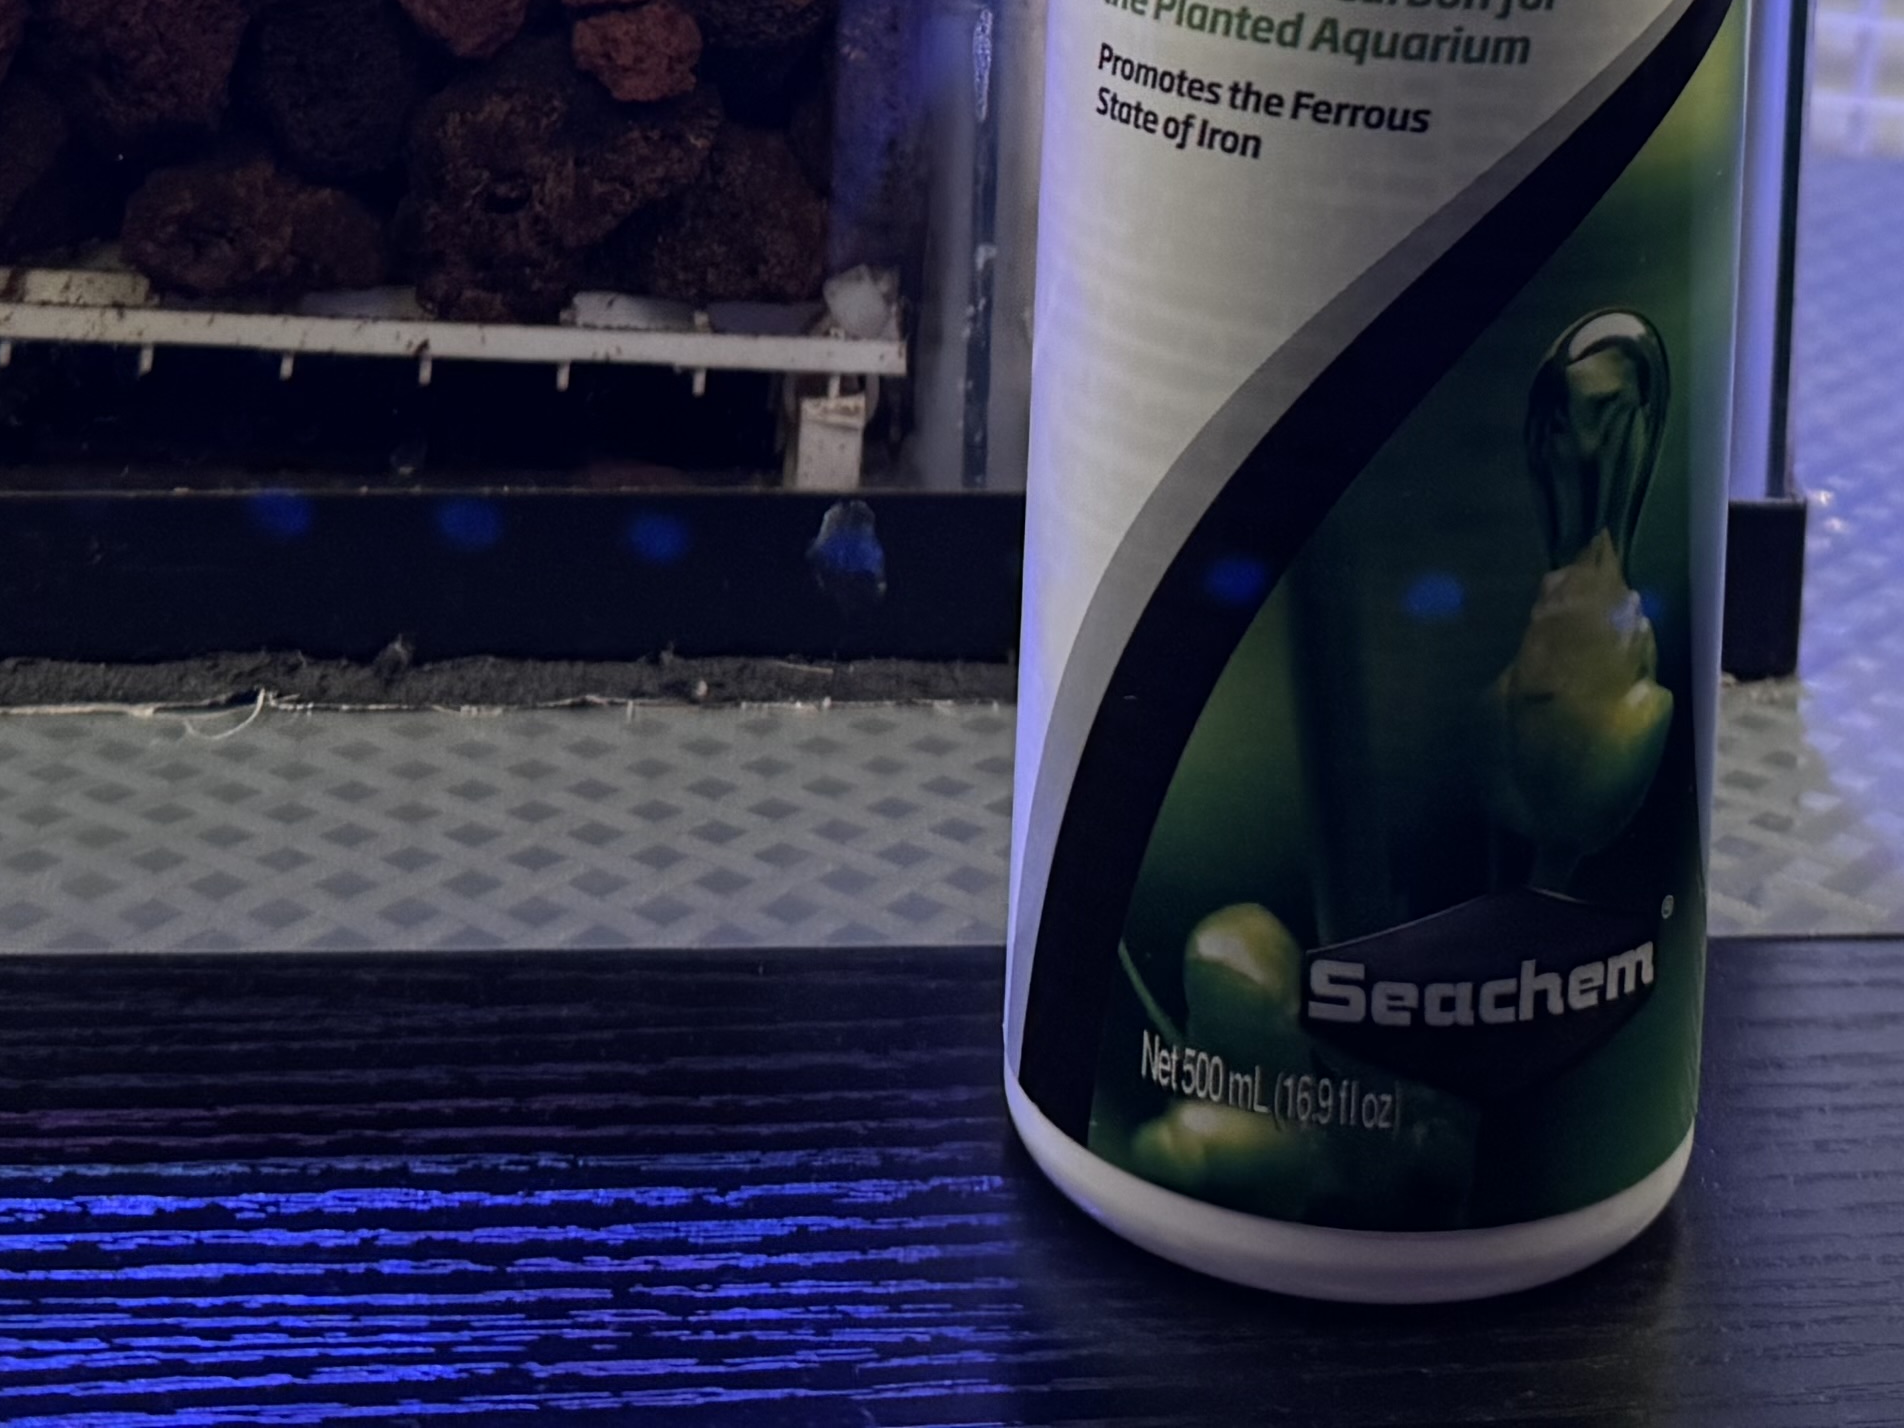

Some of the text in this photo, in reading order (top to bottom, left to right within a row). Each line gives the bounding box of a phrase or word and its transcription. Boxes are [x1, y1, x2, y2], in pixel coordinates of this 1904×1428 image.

[1308, 16, 1532, 67] Aquarium
[1096, 86, 1263, 160] State of Iron
[1097, 41, 1433, 134] Promotes the Ferrous
[1140, 1028, 1178, 1092] Net
[1181, 1047, 1223, 1102] 500
[1228, 1064, 1271, 1114] mL
[1339, 1079, 1360, 1127] fl
